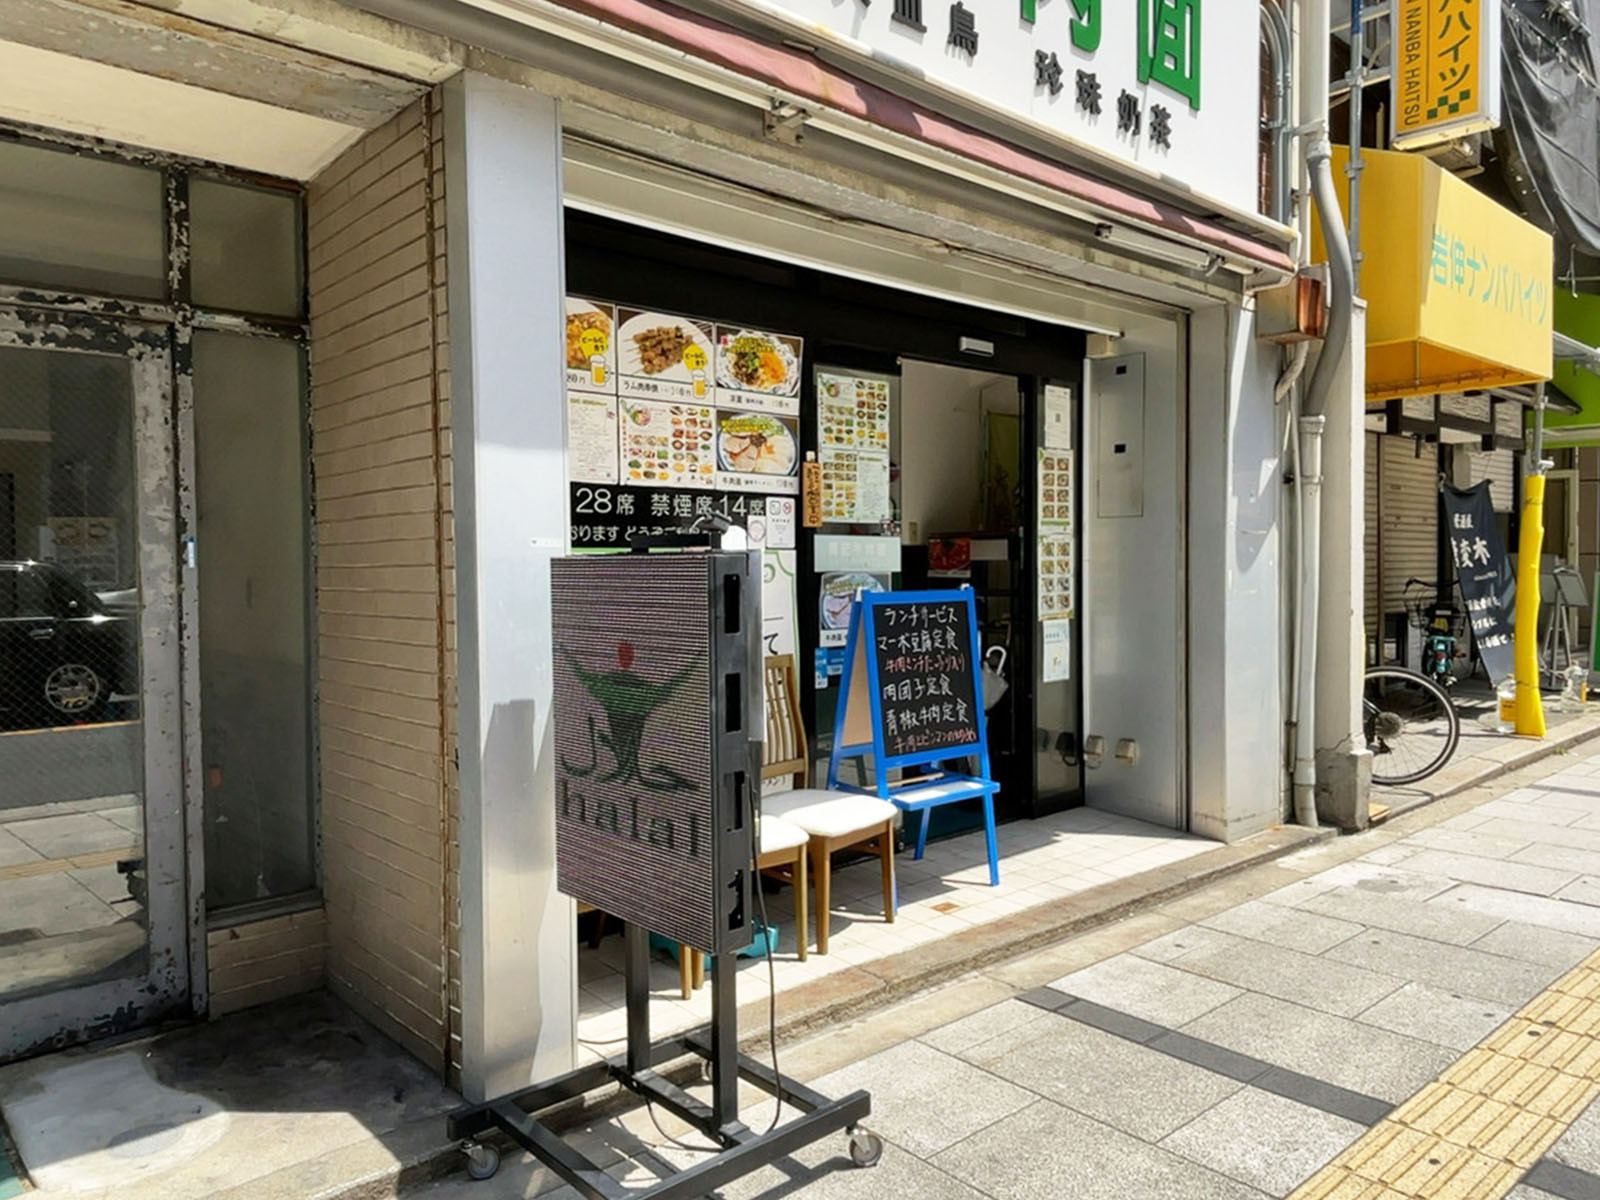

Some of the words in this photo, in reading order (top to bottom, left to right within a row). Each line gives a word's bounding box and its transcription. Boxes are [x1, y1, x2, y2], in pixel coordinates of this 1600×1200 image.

[1405, 8, 1422, 65] NANBA
[1035, 49, 1172, 149] 珍珠奶茶
[1404, 67, 1422, 126] HAITSU
[557, 781, 702, 859] halal
